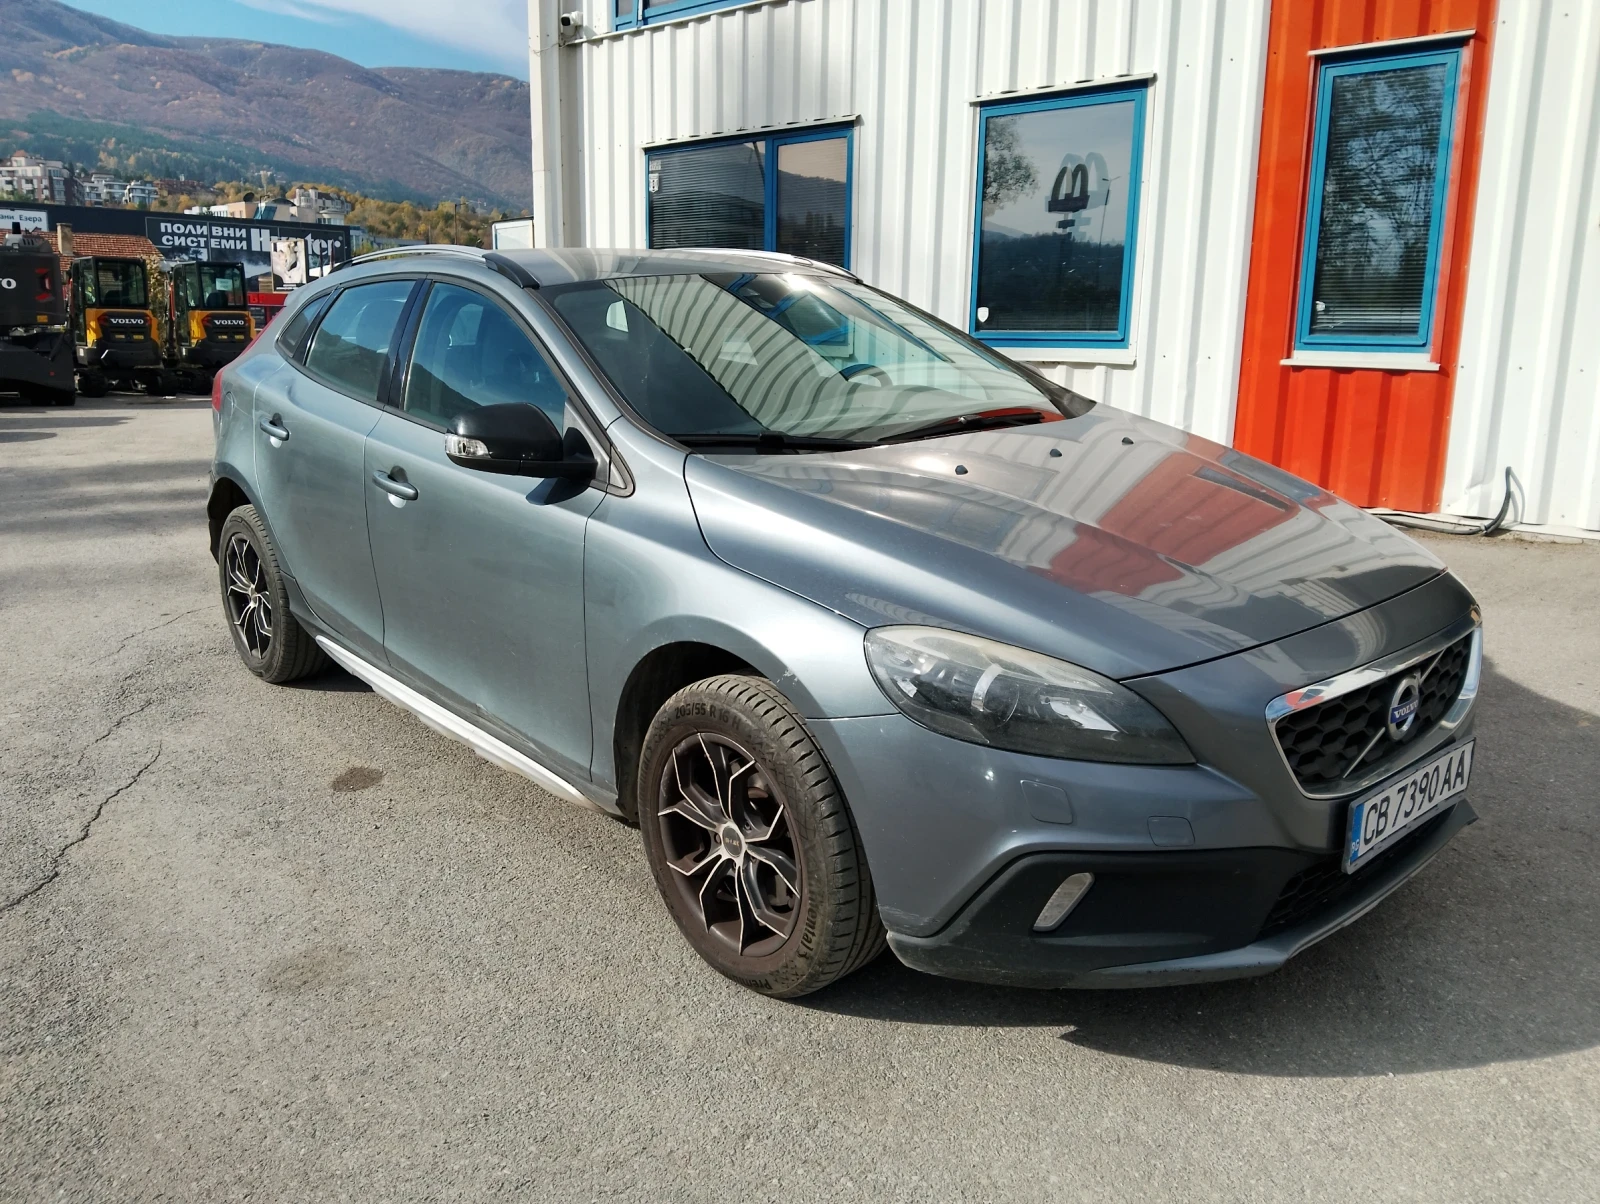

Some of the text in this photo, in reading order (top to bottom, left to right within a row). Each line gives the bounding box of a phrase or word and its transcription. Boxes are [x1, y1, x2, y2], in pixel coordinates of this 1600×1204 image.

[19, 215, 42, 223] Езера
[251, 228, 342, 255] Hter
[675, 703, 706, 719] 205/55
[709, 705, 716, 718] R
[1394, 699, 1418, 718] VOLVO
[1364, 749, 1466, 845] CB 7390 AA
[1352, 839, 1360, 853] BG
